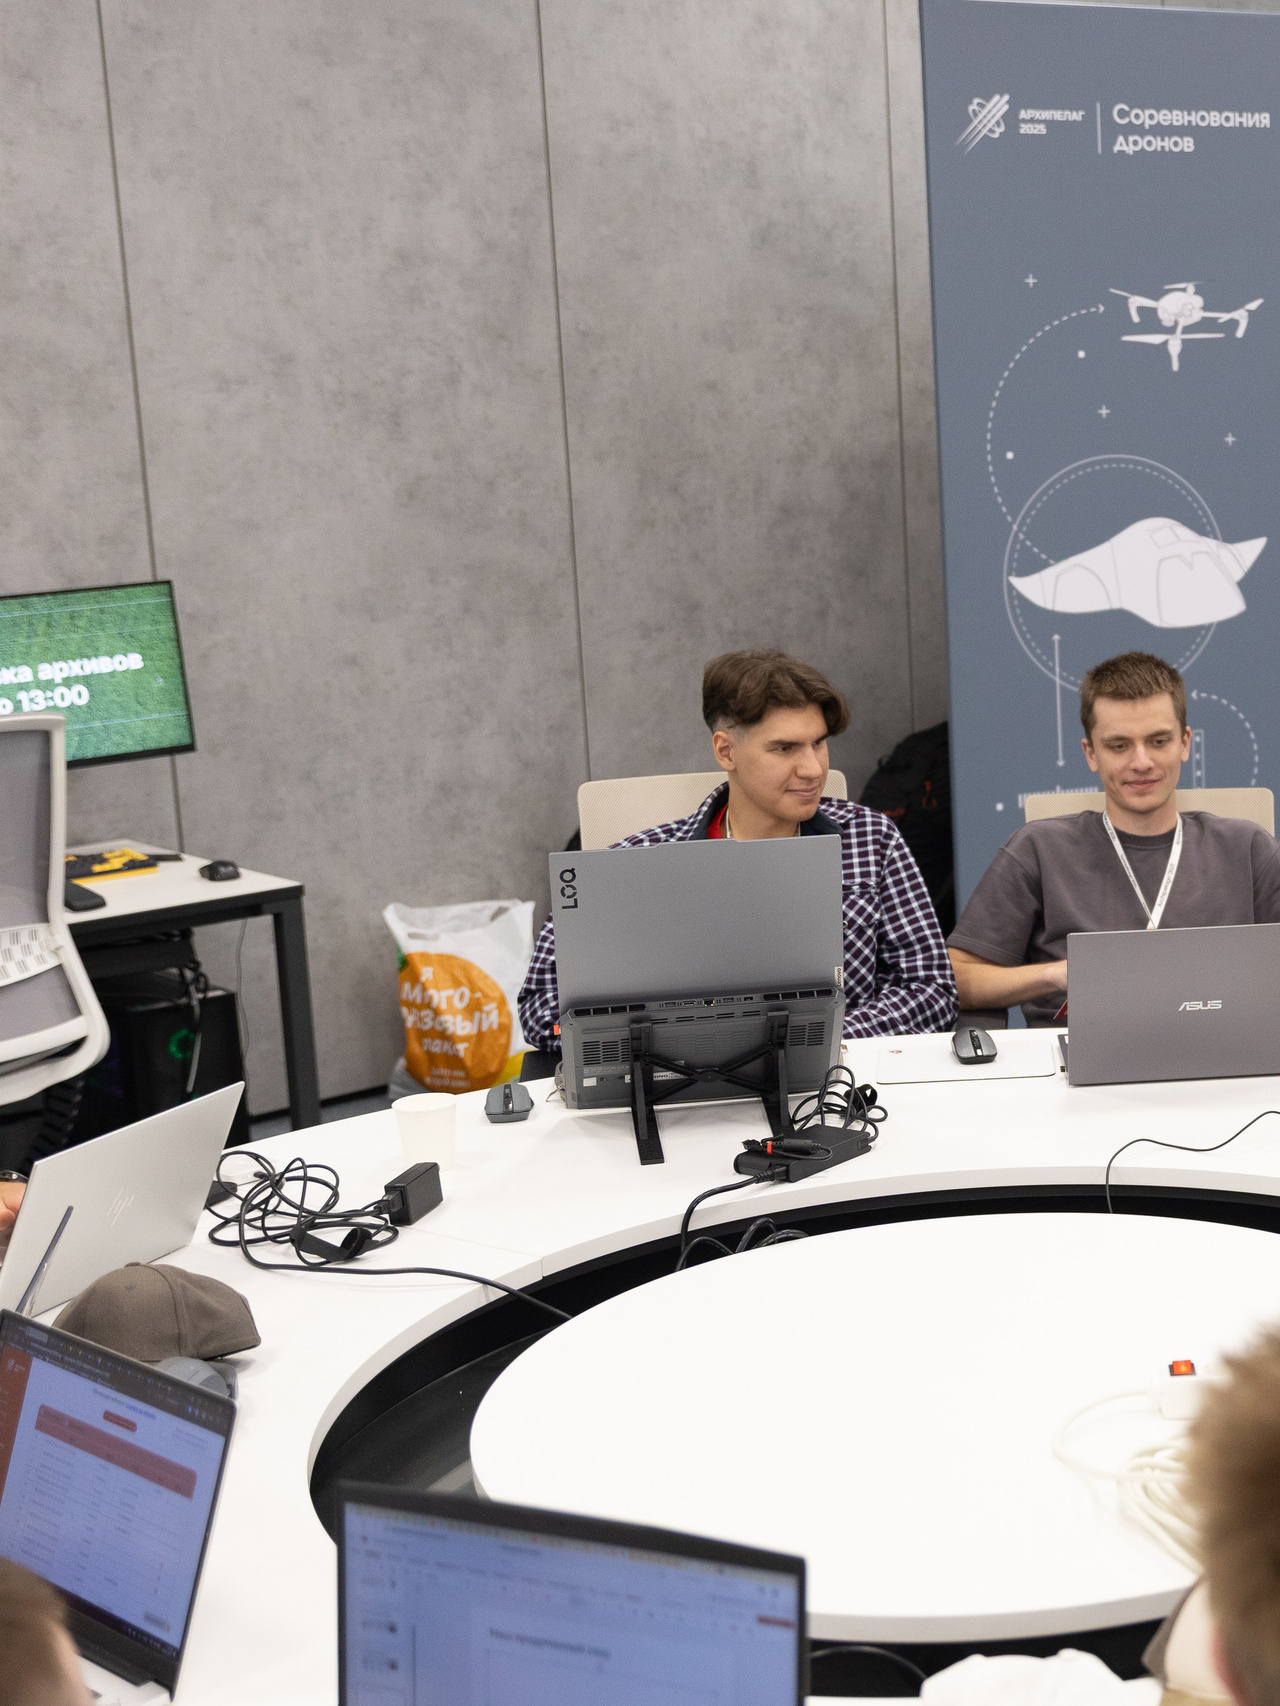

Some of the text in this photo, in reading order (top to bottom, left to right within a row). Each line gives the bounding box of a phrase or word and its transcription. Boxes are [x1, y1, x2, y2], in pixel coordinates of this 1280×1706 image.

[1018, 108, 1086, 122] АРХИПЕЛАГ
[1112, 103, 1271, 130] Соревнования
[1019, 122, 1047, 135] 2025
[1112, 134, 1195, 156] дронов
[37, 653, 144, 684] архивов
[16, 684, 90, 713] 13:00
[559, 866, 579, 911] LOQ
[1178, 1000, 1222, 1012] ASUS
